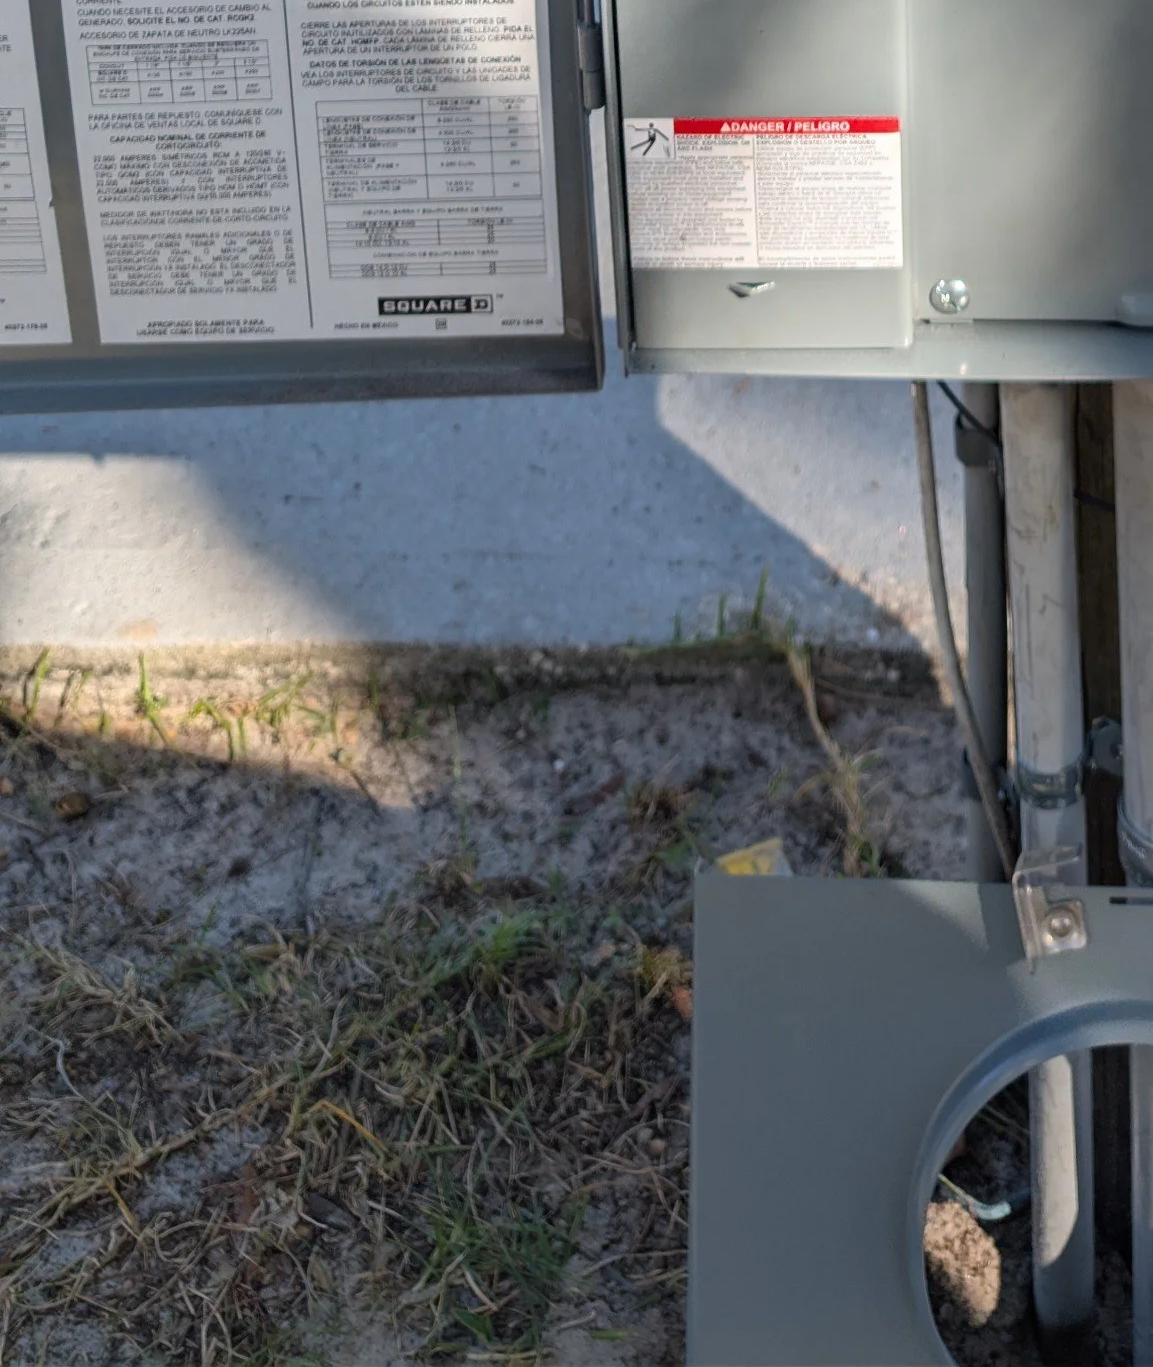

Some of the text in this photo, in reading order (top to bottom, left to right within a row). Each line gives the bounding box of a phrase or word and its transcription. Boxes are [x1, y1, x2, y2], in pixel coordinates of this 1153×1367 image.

[731, 122, 784, 131] DANGER
[794, 122, 850, 131] PELIGRO
[383, 299, 467, 312] SQUARE
